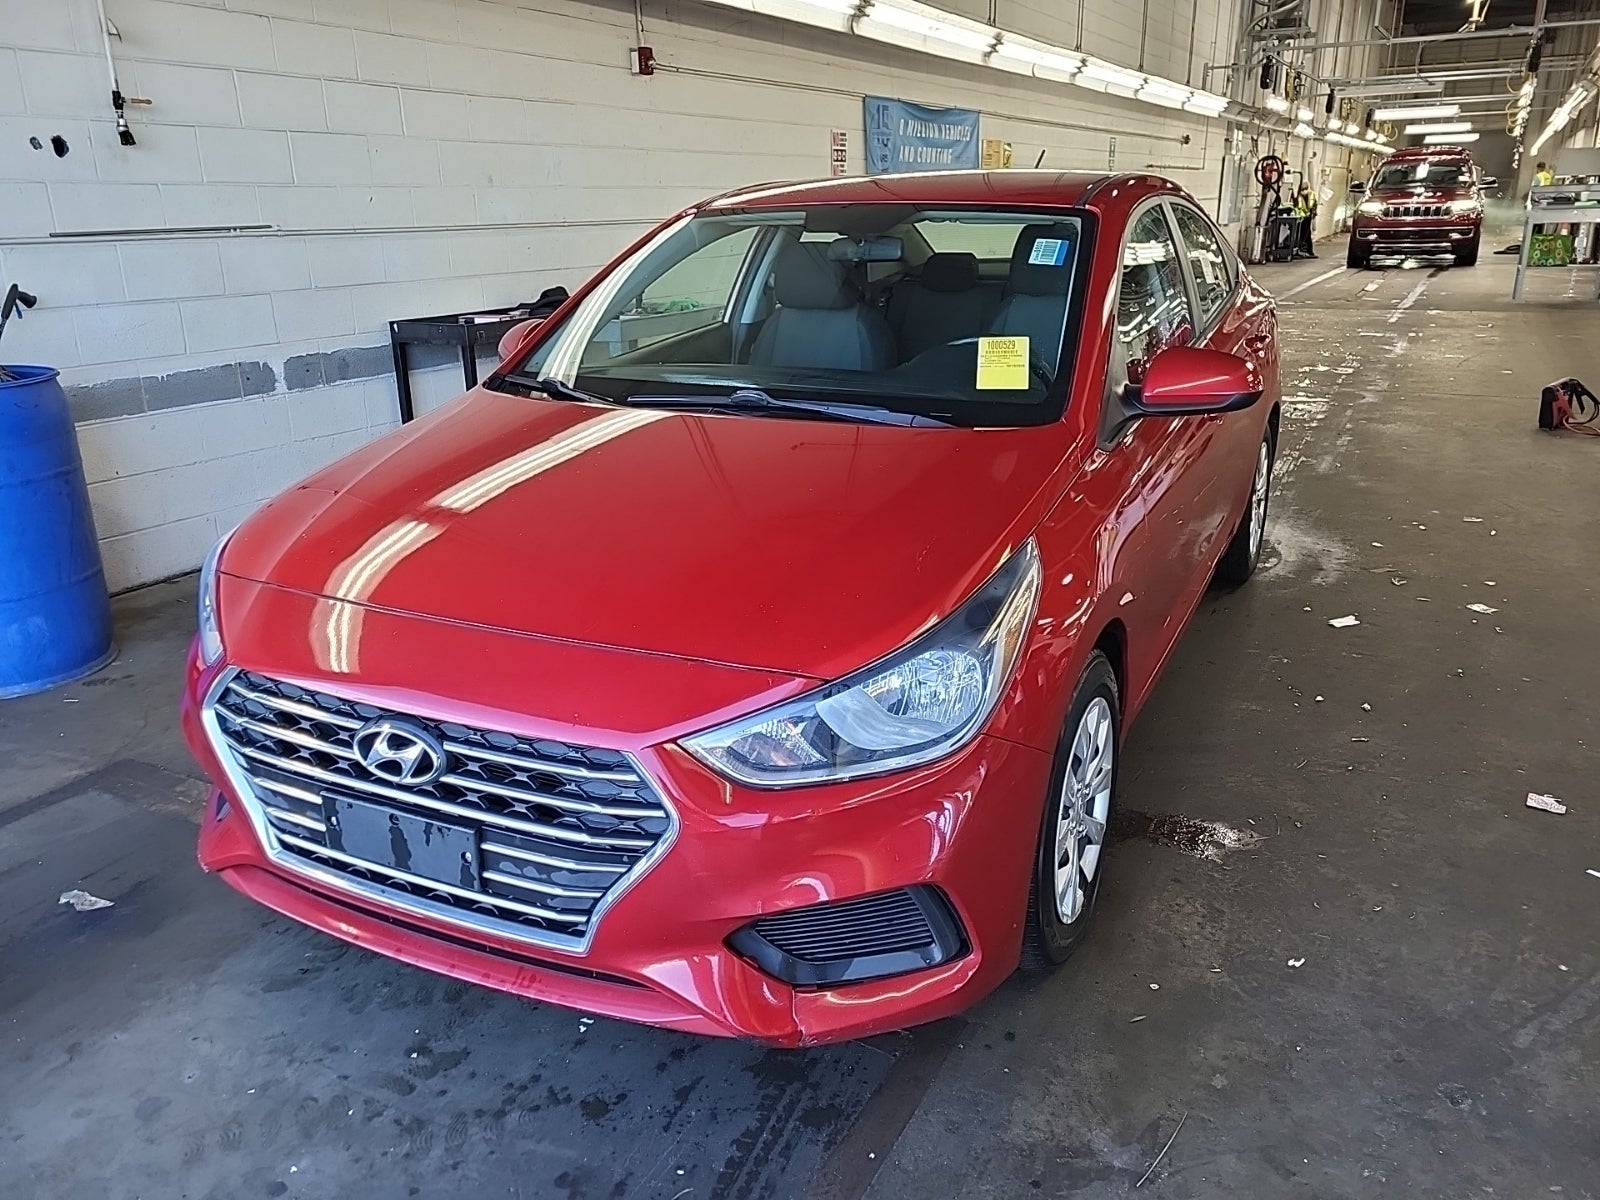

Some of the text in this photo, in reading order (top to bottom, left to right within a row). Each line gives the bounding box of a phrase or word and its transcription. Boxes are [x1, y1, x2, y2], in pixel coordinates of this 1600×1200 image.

[906, 119, 939, 139] MILLION
[940, 123, 971, 142] VEHICLES
[898, 145, 953, 165] AND COUNTING
[987, 340, 1016, 350] 1000529
